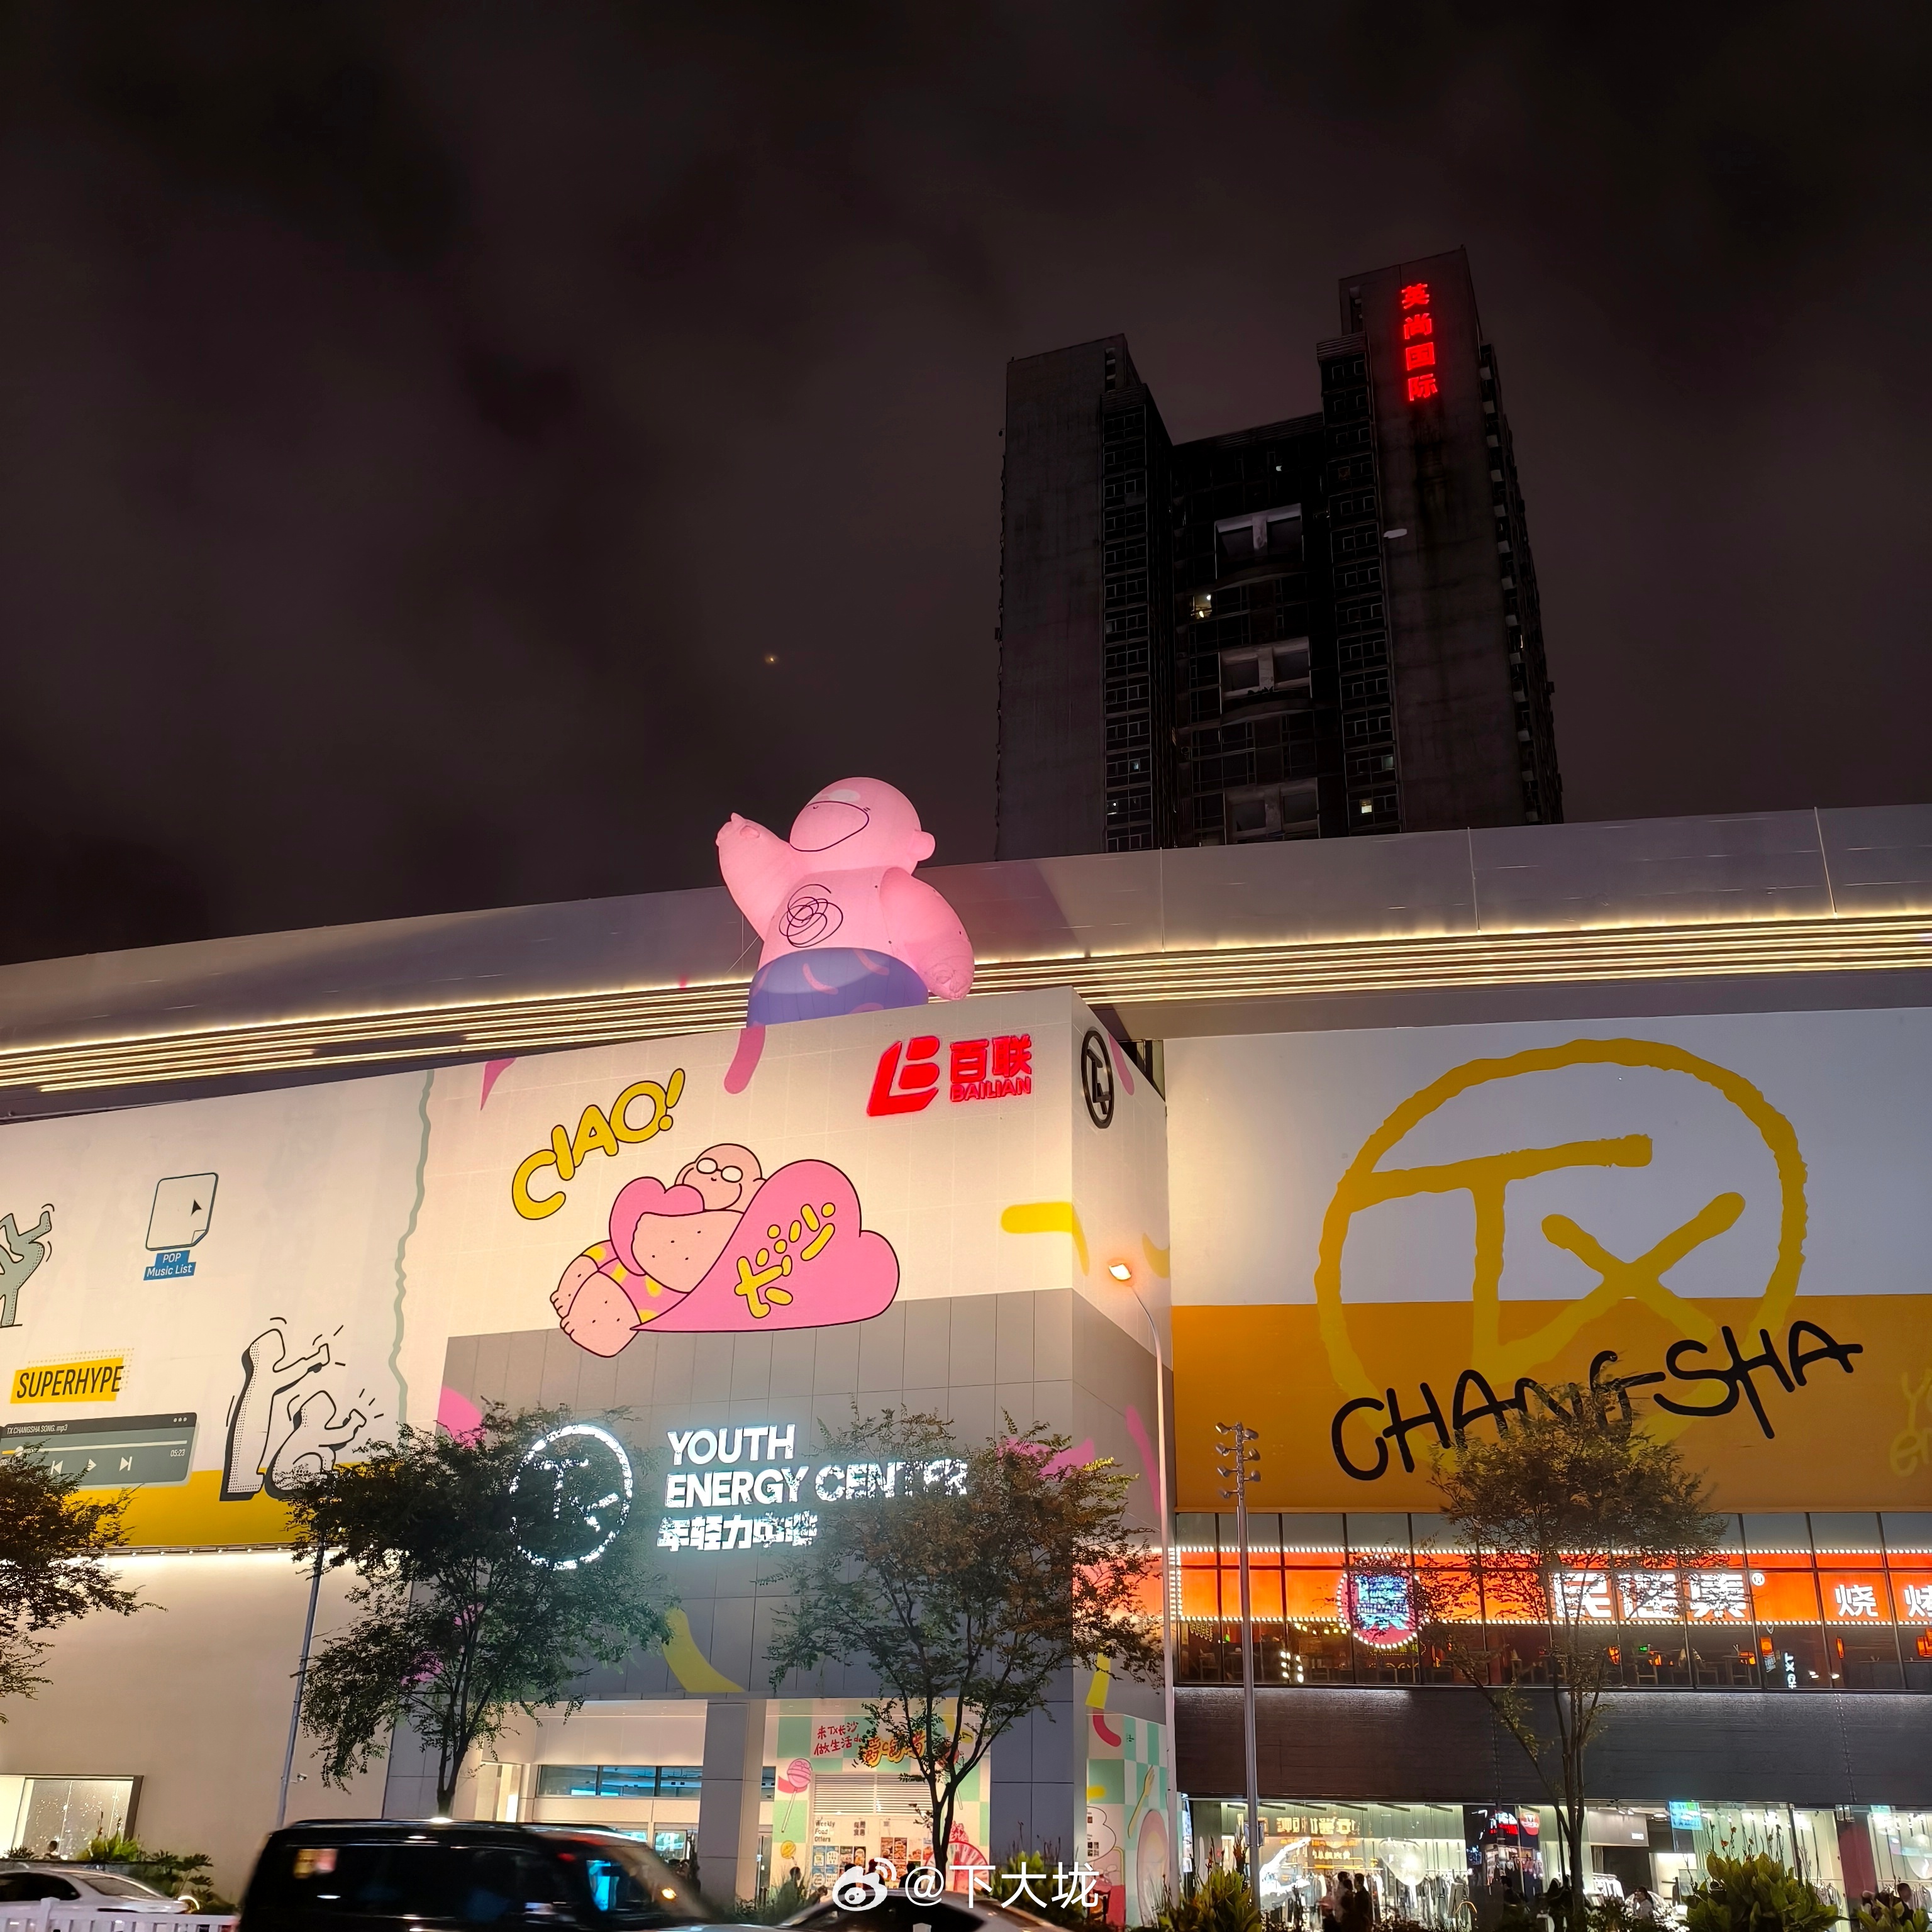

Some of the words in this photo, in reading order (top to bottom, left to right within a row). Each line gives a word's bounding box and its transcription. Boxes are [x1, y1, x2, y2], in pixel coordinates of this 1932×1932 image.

[1401, 283, 1438, 401] 英尚国际
[950, 1034, 1031, 1083] 百联
[950, 1076, 1031, 1102] BAILIAN
[512, 1068, 686, 1220] CIAO!
[146, 1265, 174, 1277] Music
[175, 1264, 192, 1274] List
[163, 1253, 181, 1263] POP
[16, 1365, 124, 1398] SUPERHYPE
[13, 1425, 40, 1433] CHANGSHA
[667, 1424, 796, 1465] YOUTH
[170, 1448, 185, 1457] 05:23
[665, 1466, 809, 1508] ENERGY
